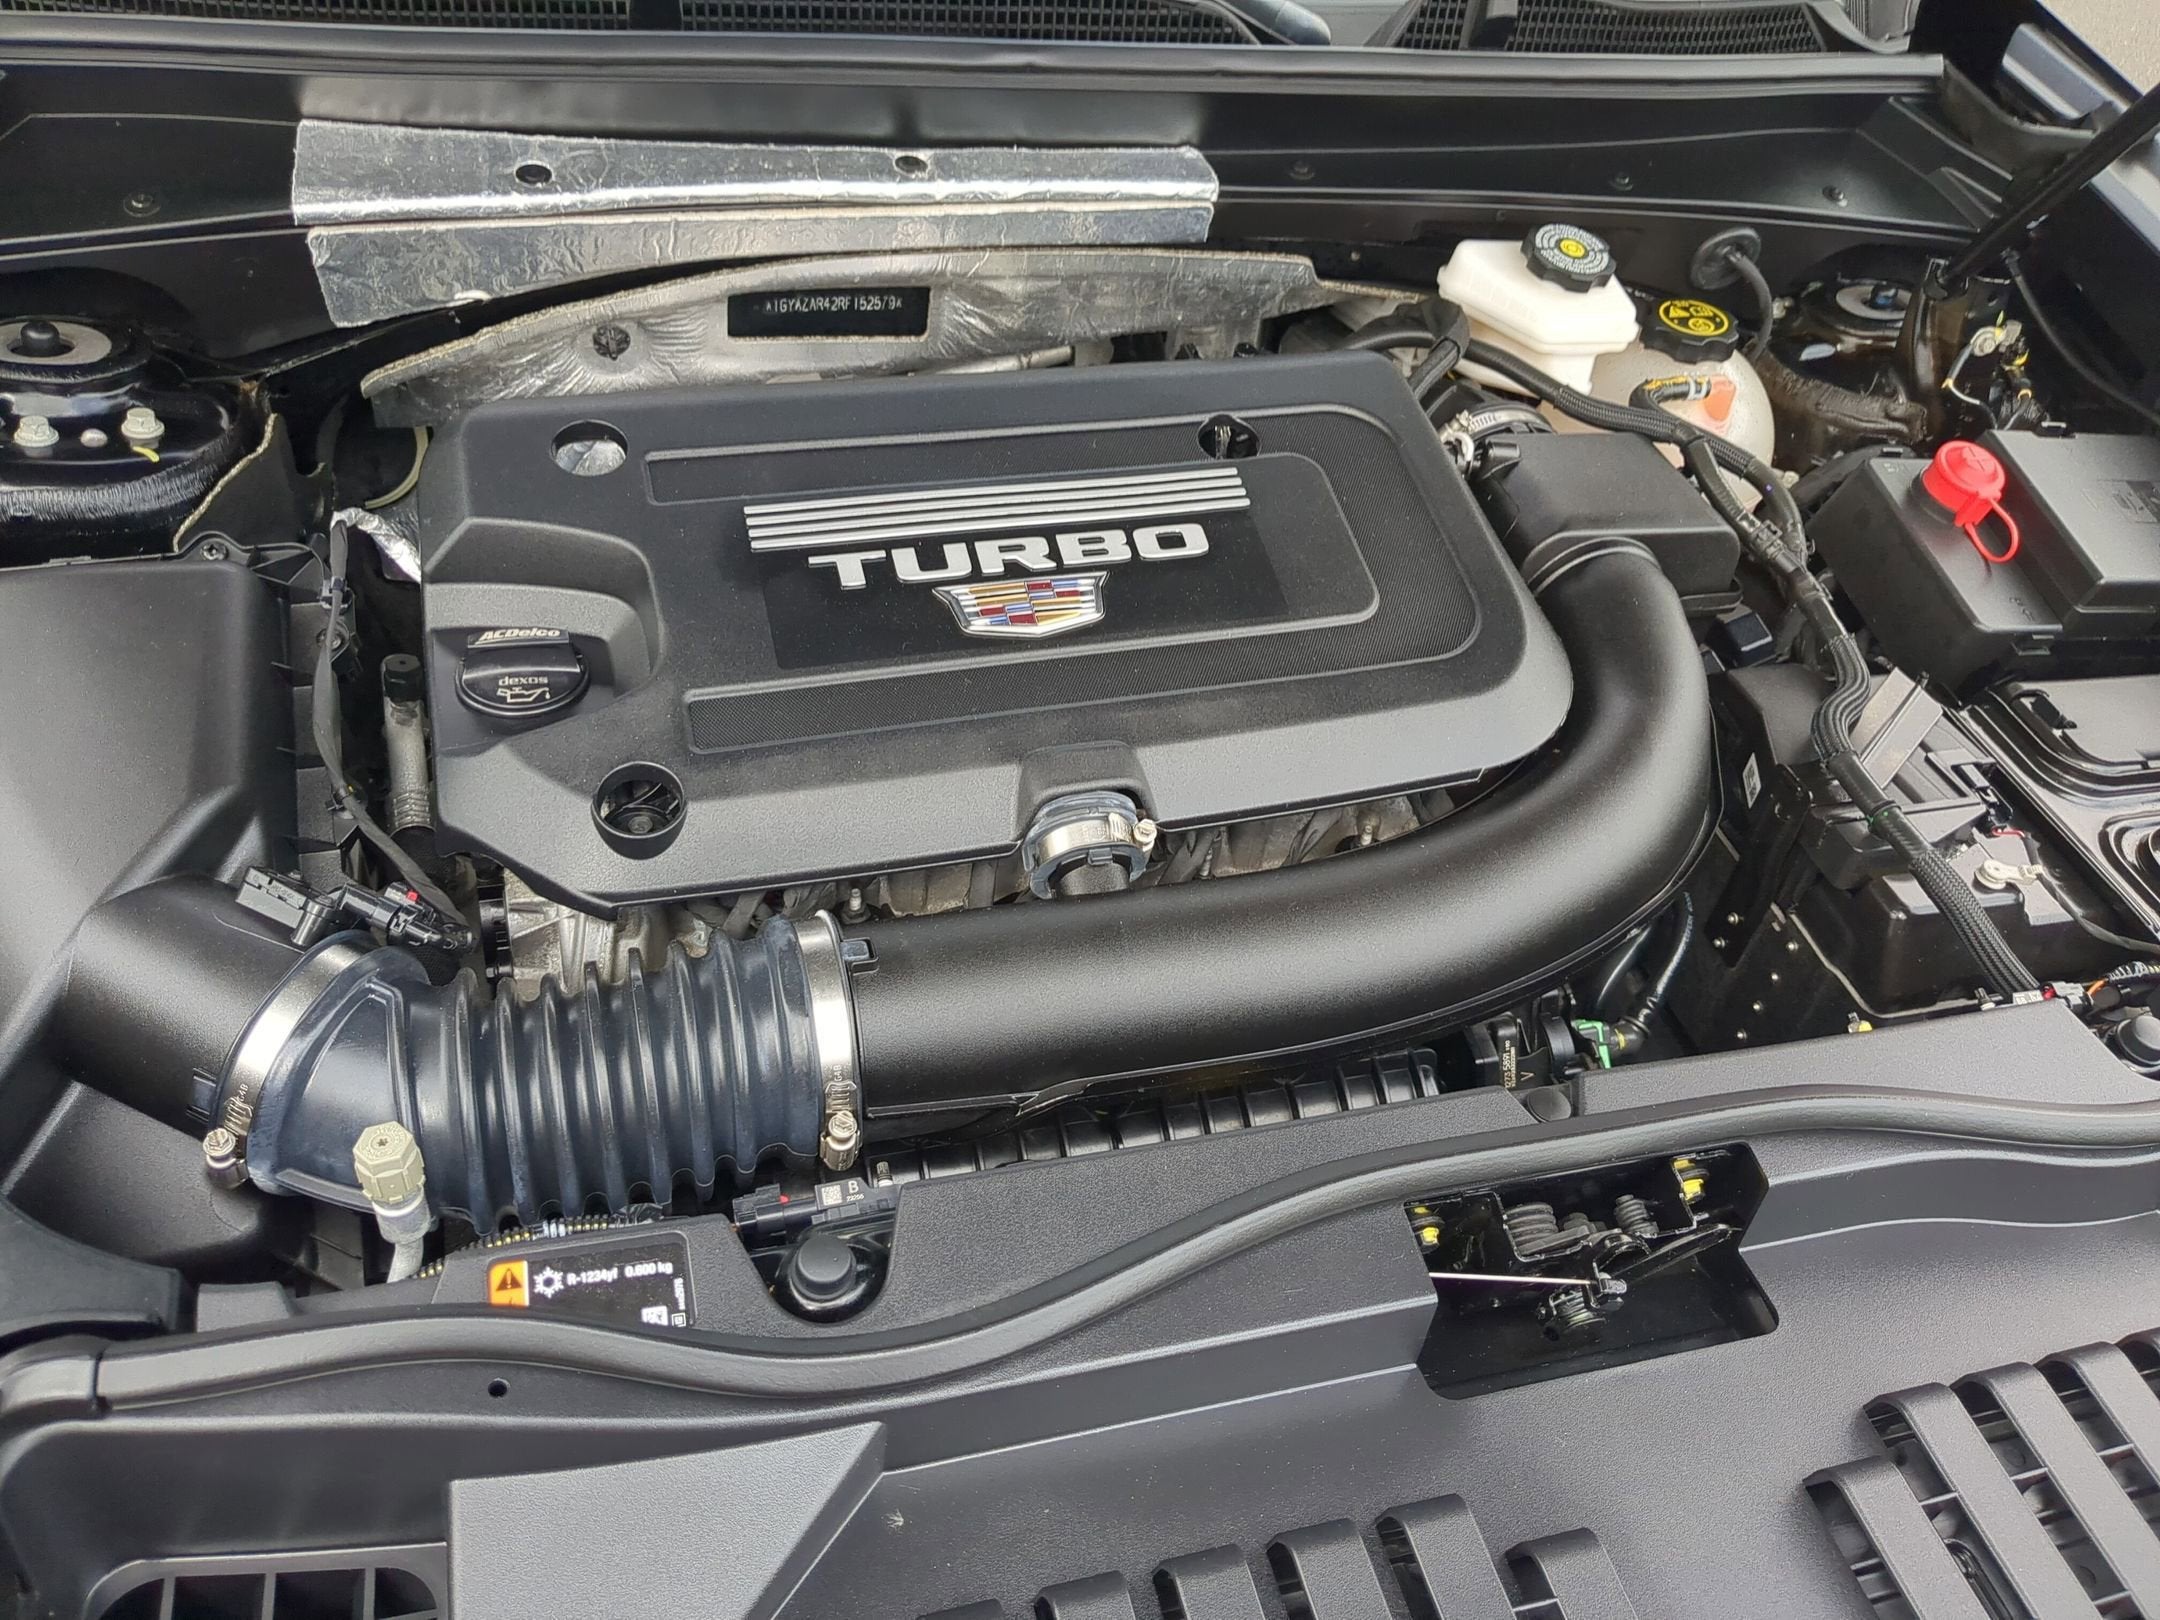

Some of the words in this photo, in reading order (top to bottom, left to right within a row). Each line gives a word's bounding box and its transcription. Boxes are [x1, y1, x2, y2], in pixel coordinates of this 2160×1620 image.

[807, 522, 1210, 590] TURBO
[479, 627, 561, 642] ACDelco
[498, 675, 549, 686] dexos
[847, 1180, 859, 1193] B
[657, 1261, 673, 1274] kg
